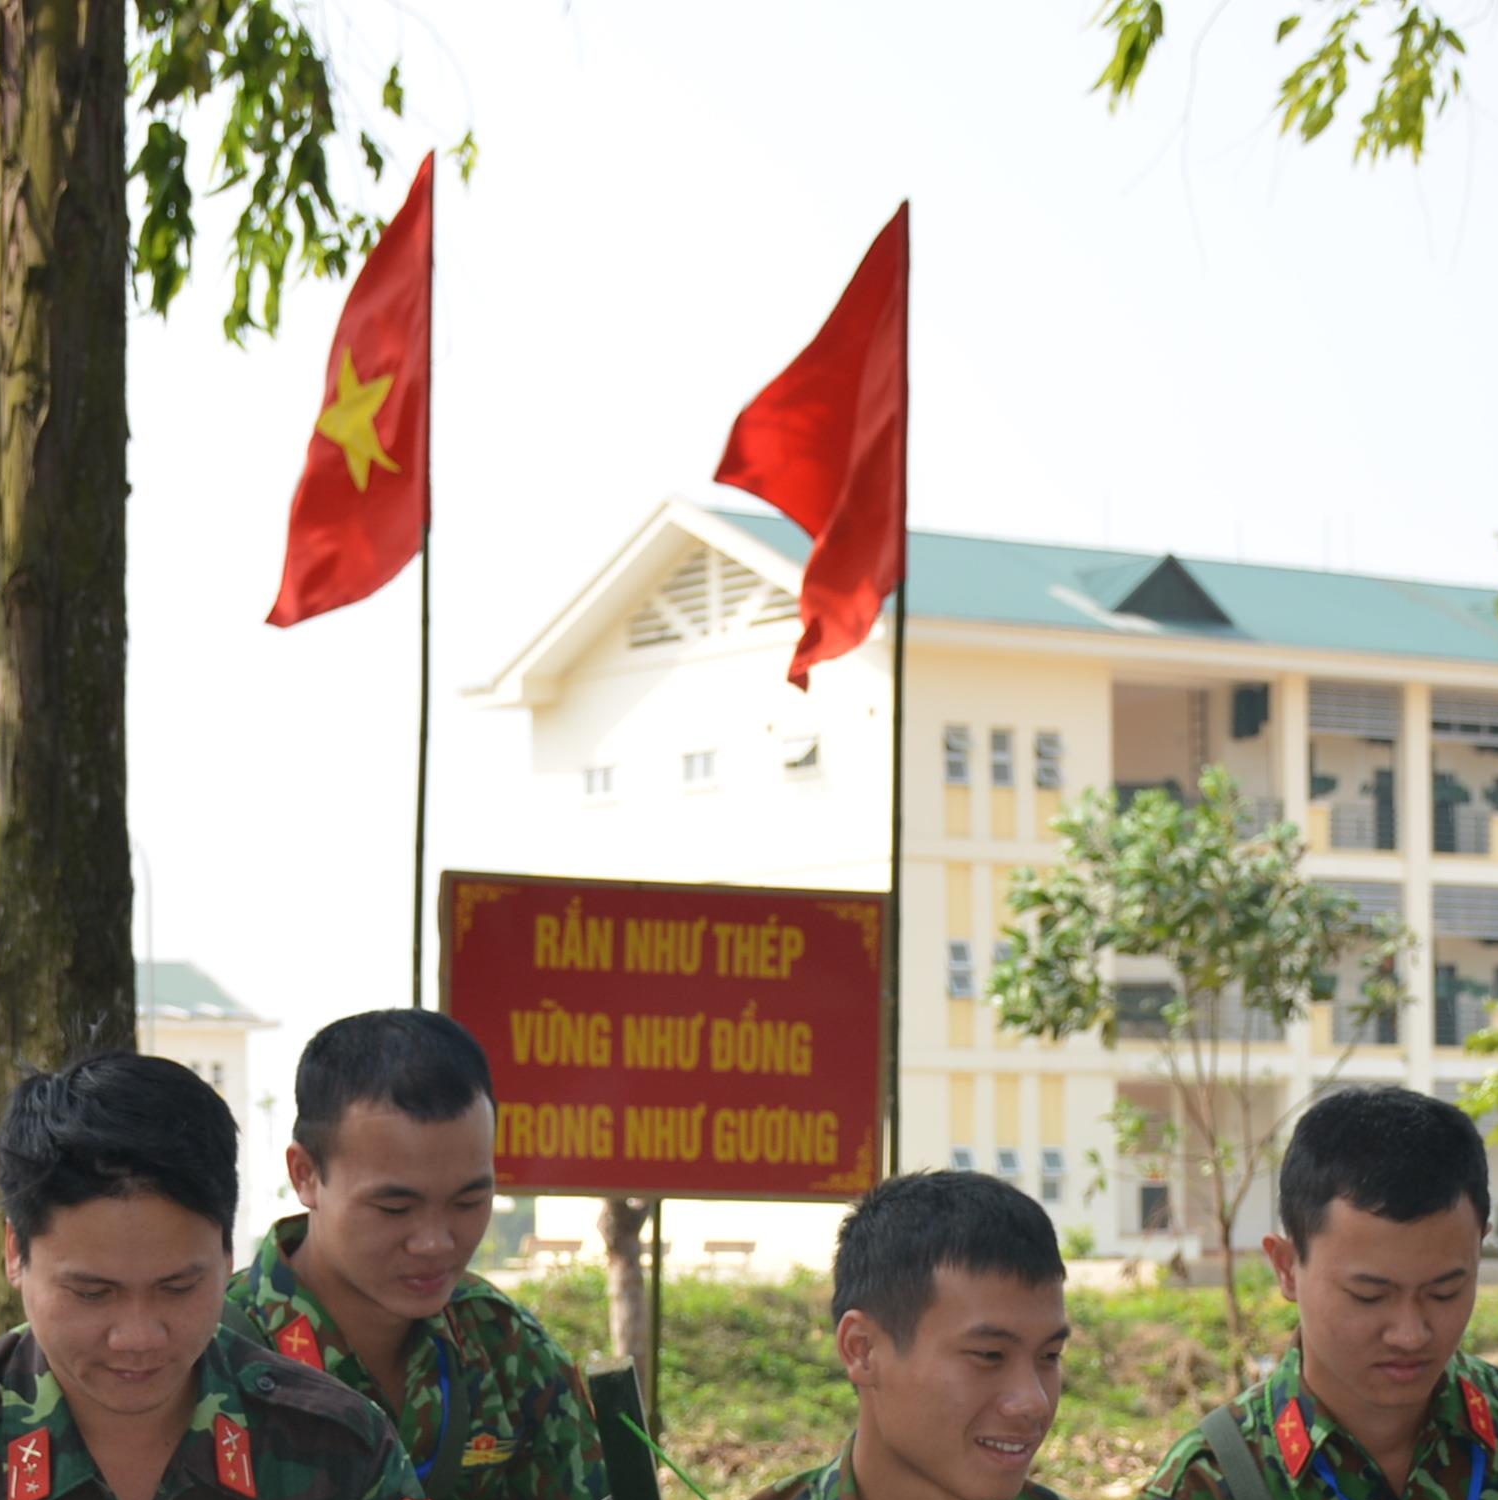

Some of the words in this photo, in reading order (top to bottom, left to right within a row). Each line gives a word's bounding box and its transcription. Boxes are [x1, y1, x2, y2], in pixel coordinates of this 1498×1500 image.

[534, 896, 613, 972] RẮN
[624, 915, 707, 975] NHƯ
[712, 913, 805, 980] THÉP
[510, 998, 612, 1068] VỮNG
[623, 1013, 706, 1071] NHƯ
[624, 1103, 706, 1161] NHƯ
[713, 1105, 839, 1165] GƯƠNG
